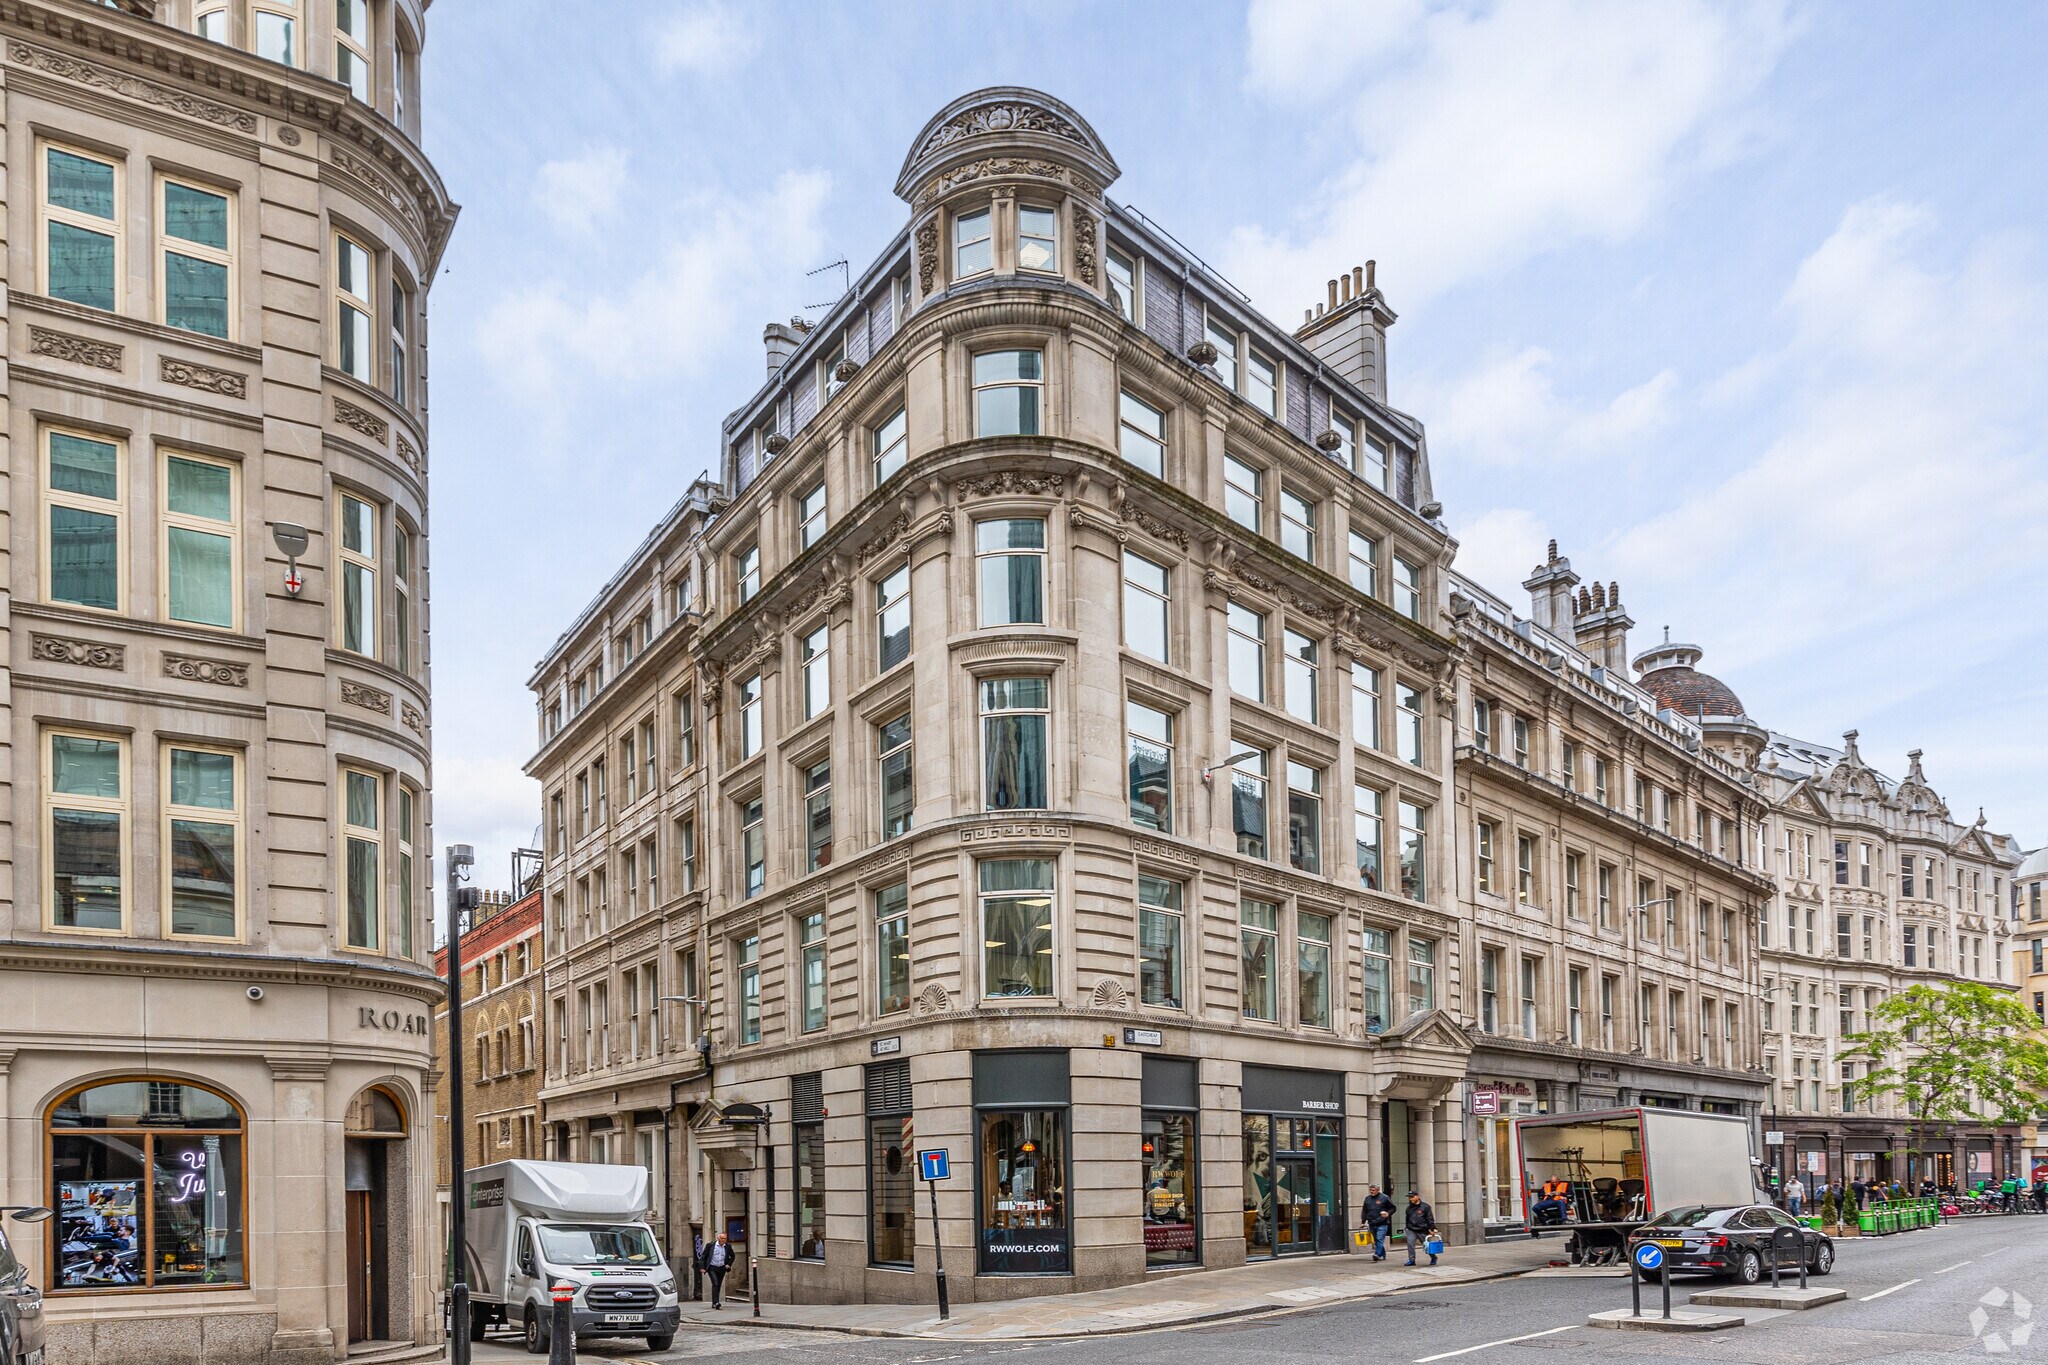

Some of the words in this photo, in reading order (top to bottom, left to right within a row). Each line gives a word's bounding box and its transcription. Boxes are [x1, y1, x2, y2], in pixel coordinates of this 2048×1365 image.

[358, 1006, 428, 1036] ROAR
[1302, 1100, 1324, 1109] BARBER
[1325, 1101, 1340, 1110] SHOP
[989, 1244, 1060, 1253] RWWOLF.COM
